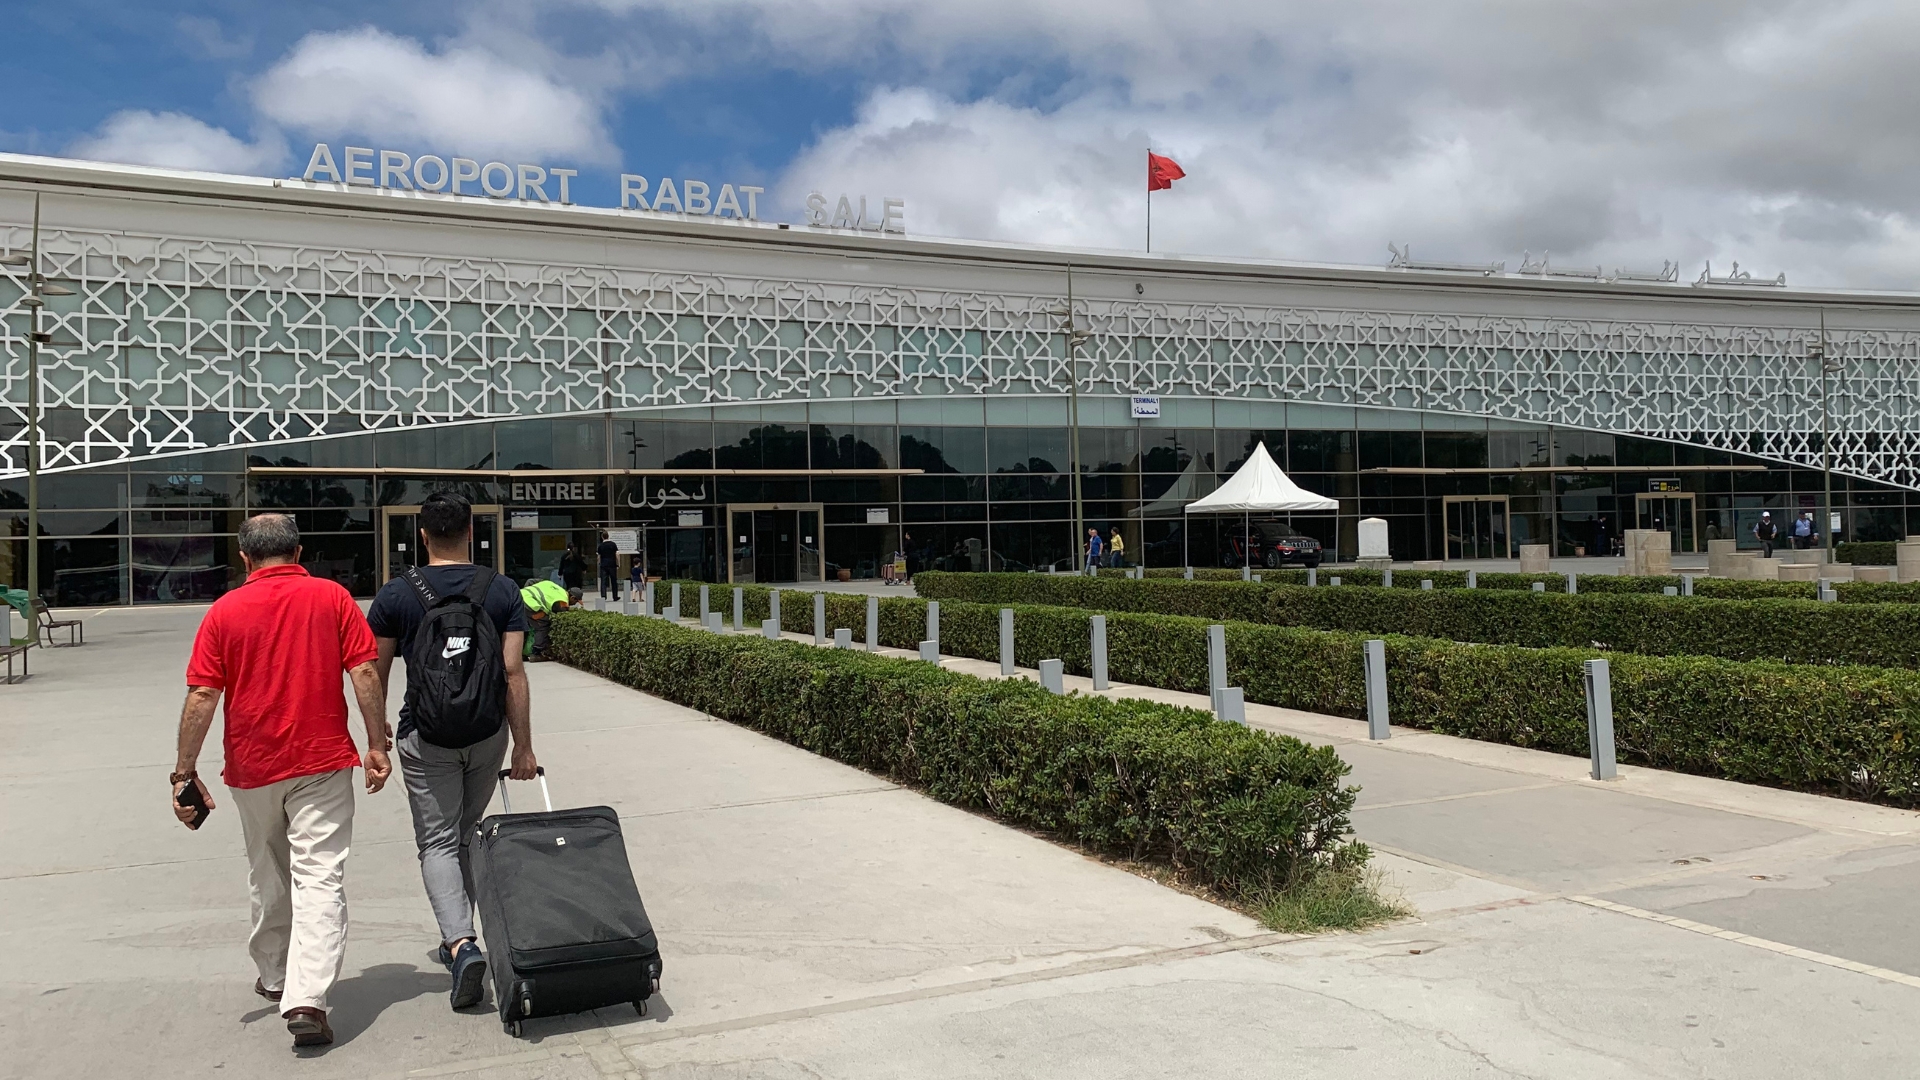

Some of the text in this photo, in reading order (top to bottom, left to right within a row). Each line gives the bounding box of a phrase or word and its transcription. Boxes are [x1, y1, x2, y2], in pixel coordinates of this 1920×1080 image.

[303, 143, 906, 234] AEROPORT RABAT SALE
[511, 482, 596, 501] ENTREE
[627, 475, 706, 510] دخول
[415, 579, 435, 601] NIKE
[446, 636, 472, 649] NIKE
